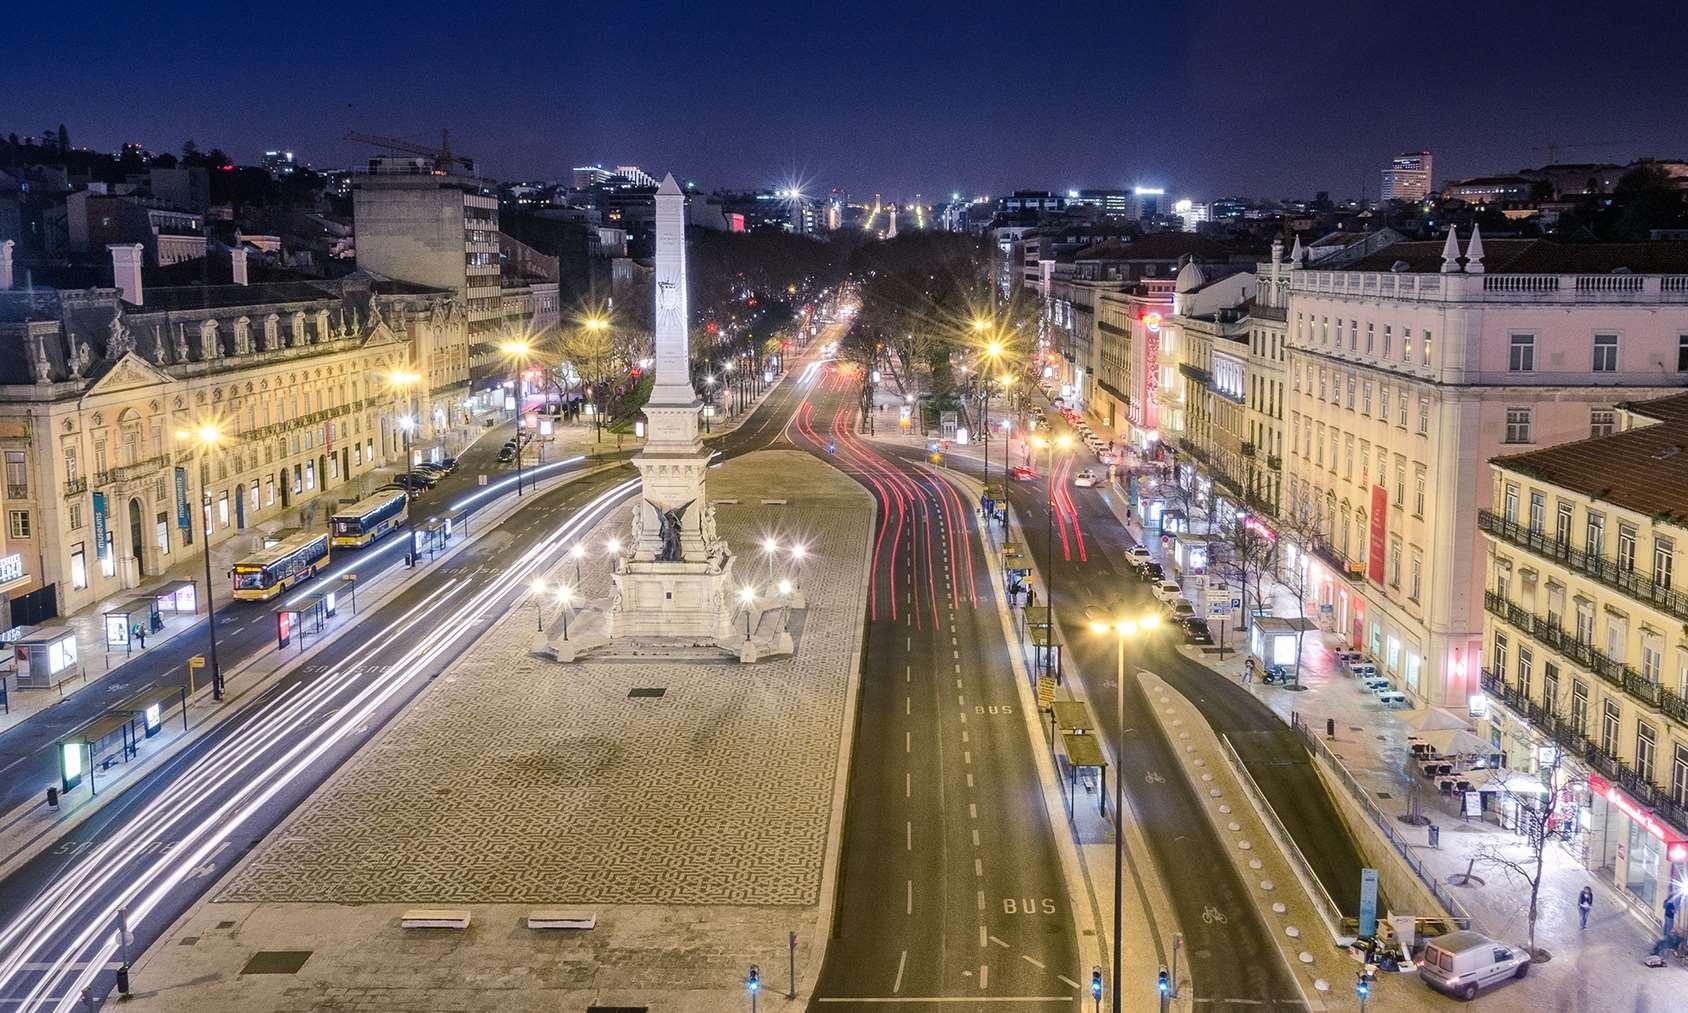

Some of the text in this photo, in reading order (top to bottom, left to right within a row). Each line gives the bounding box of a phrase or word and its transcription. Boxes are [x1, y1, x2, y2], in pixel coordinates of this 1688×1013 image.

[176, 476, 185, 518] monuments
[95, 511, 105, 549] museums
[1232, 599, 1240, 608] P
[975, 705, 1012, 715] BUS
[1003, 898, 1056, 914] BUS
